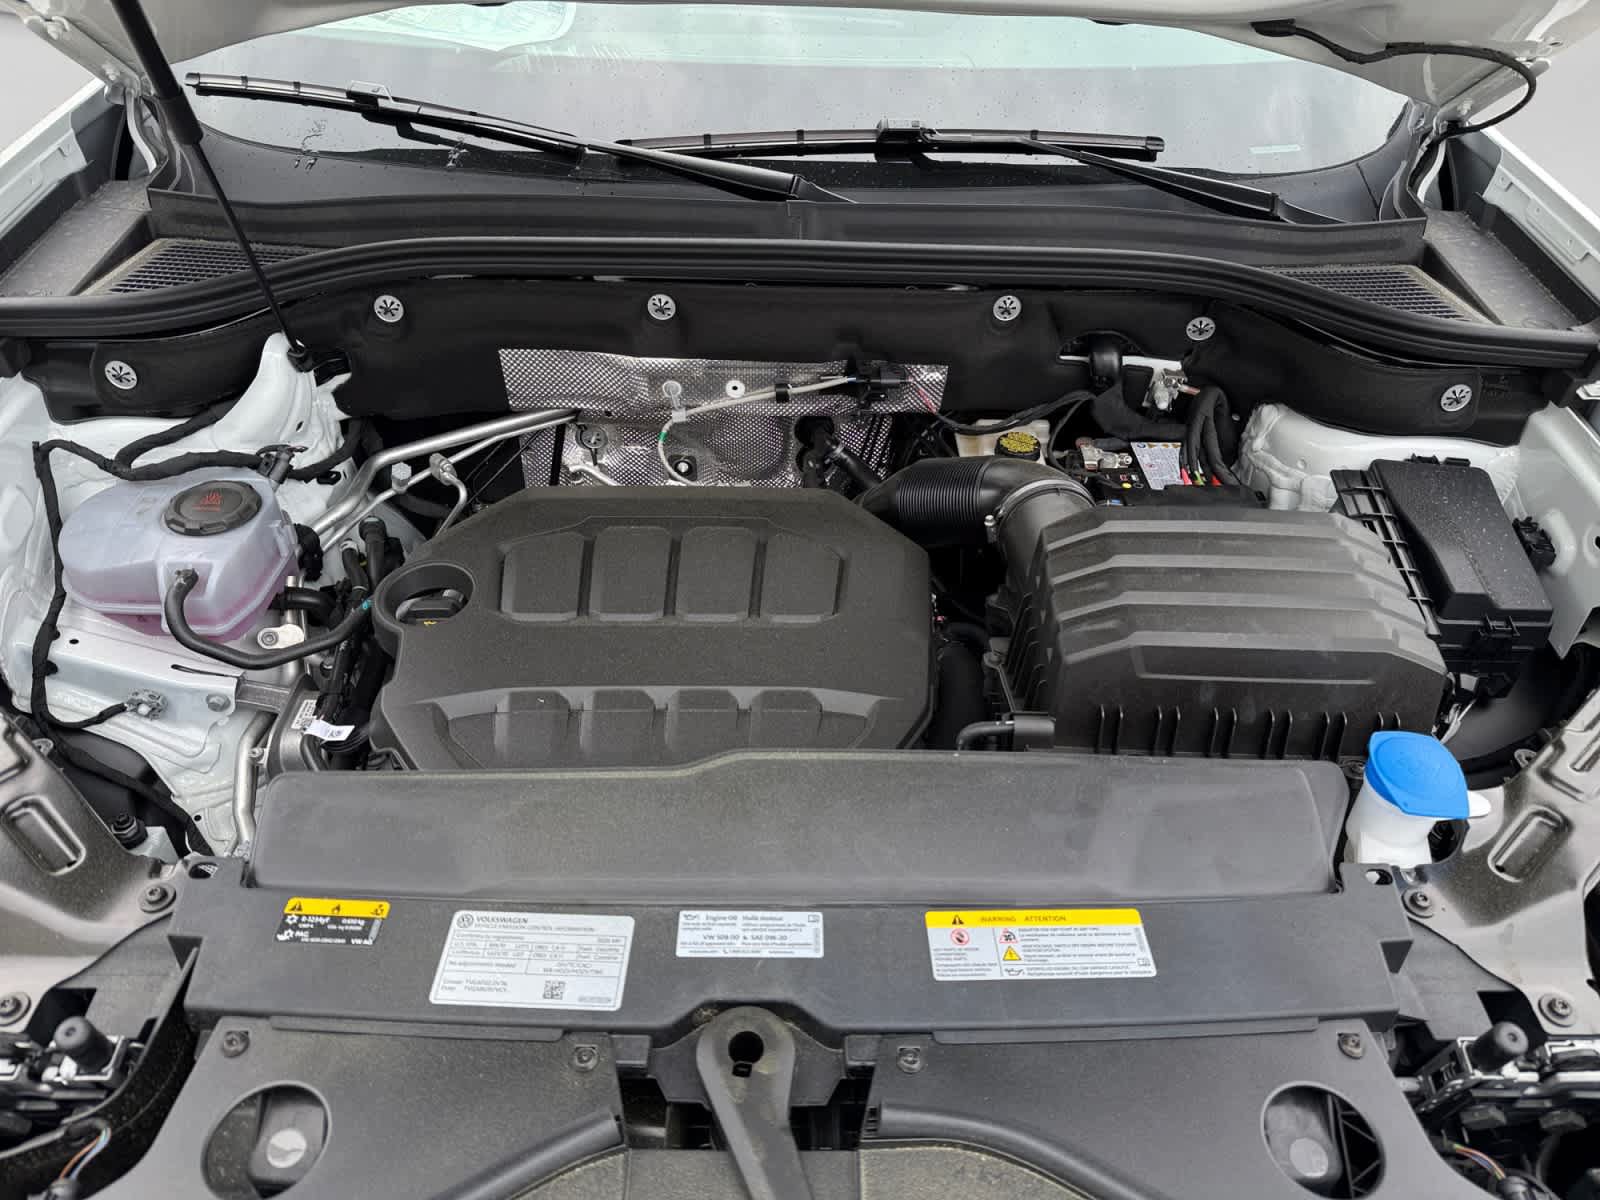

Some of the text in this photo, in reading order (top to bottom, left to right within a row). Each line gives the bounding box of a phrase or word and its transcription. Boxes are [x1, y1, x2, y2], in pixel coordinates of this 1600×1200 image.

[475, 914, 529, 924] VOLKSWAGEN
[980, 914, 1067, 923] WARNING ATTENTION
